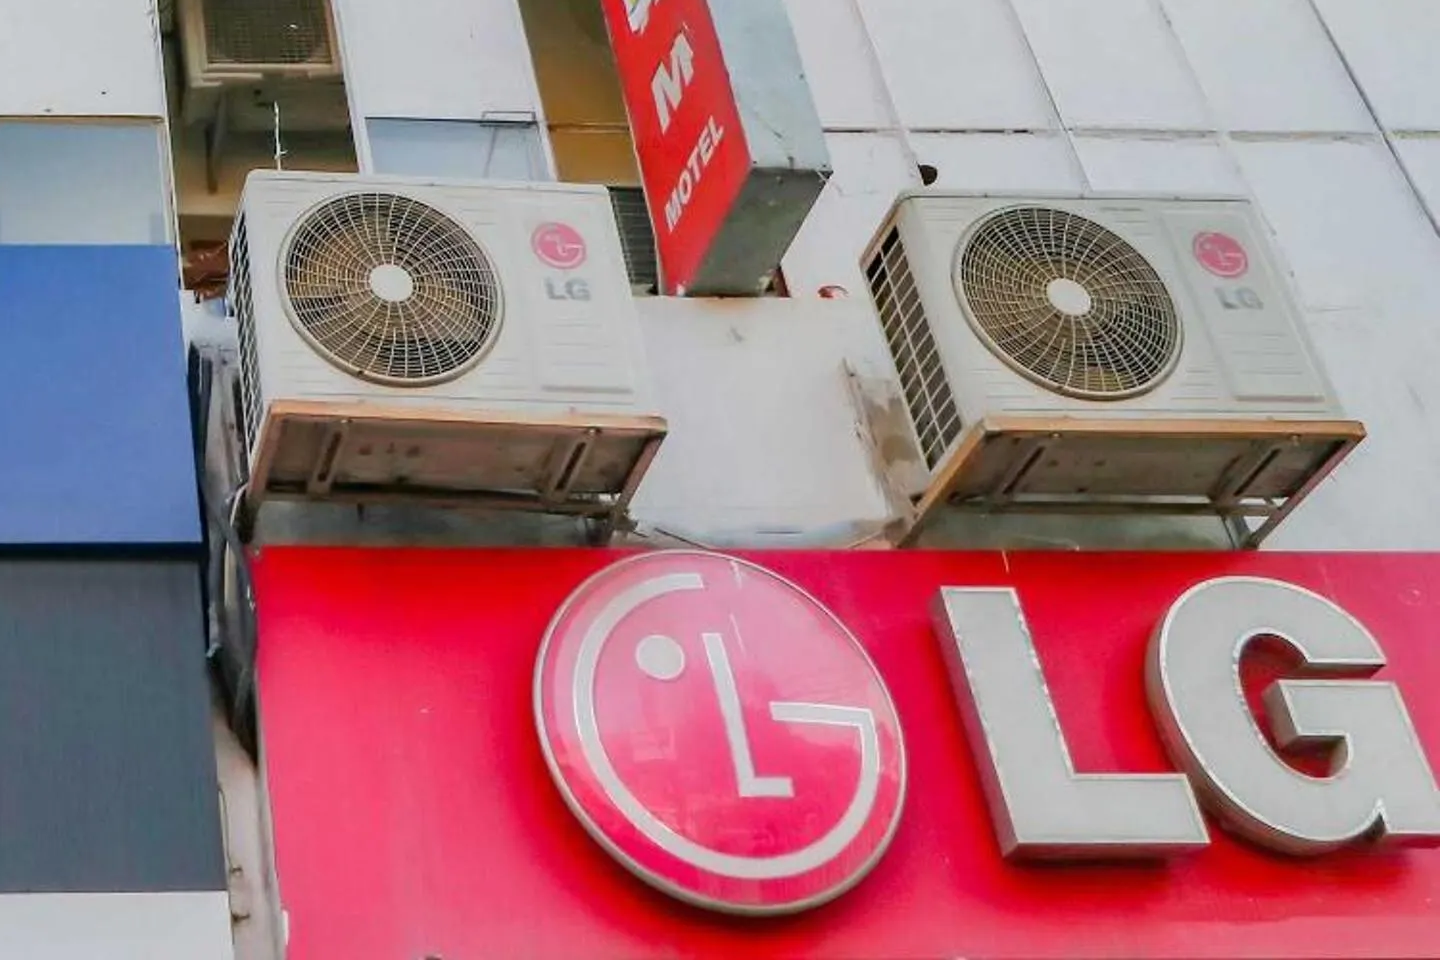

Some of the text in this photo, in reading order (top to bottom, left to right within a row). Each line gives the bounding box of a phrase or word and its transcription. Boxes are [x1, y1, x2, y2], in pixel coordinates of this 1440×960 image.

[664, 115, 724, 234] MOTEL
[544, 276, 591, 301] LG
[1214, 286, 1264, 310] LG
[934, 576, 1440, 862] LG
